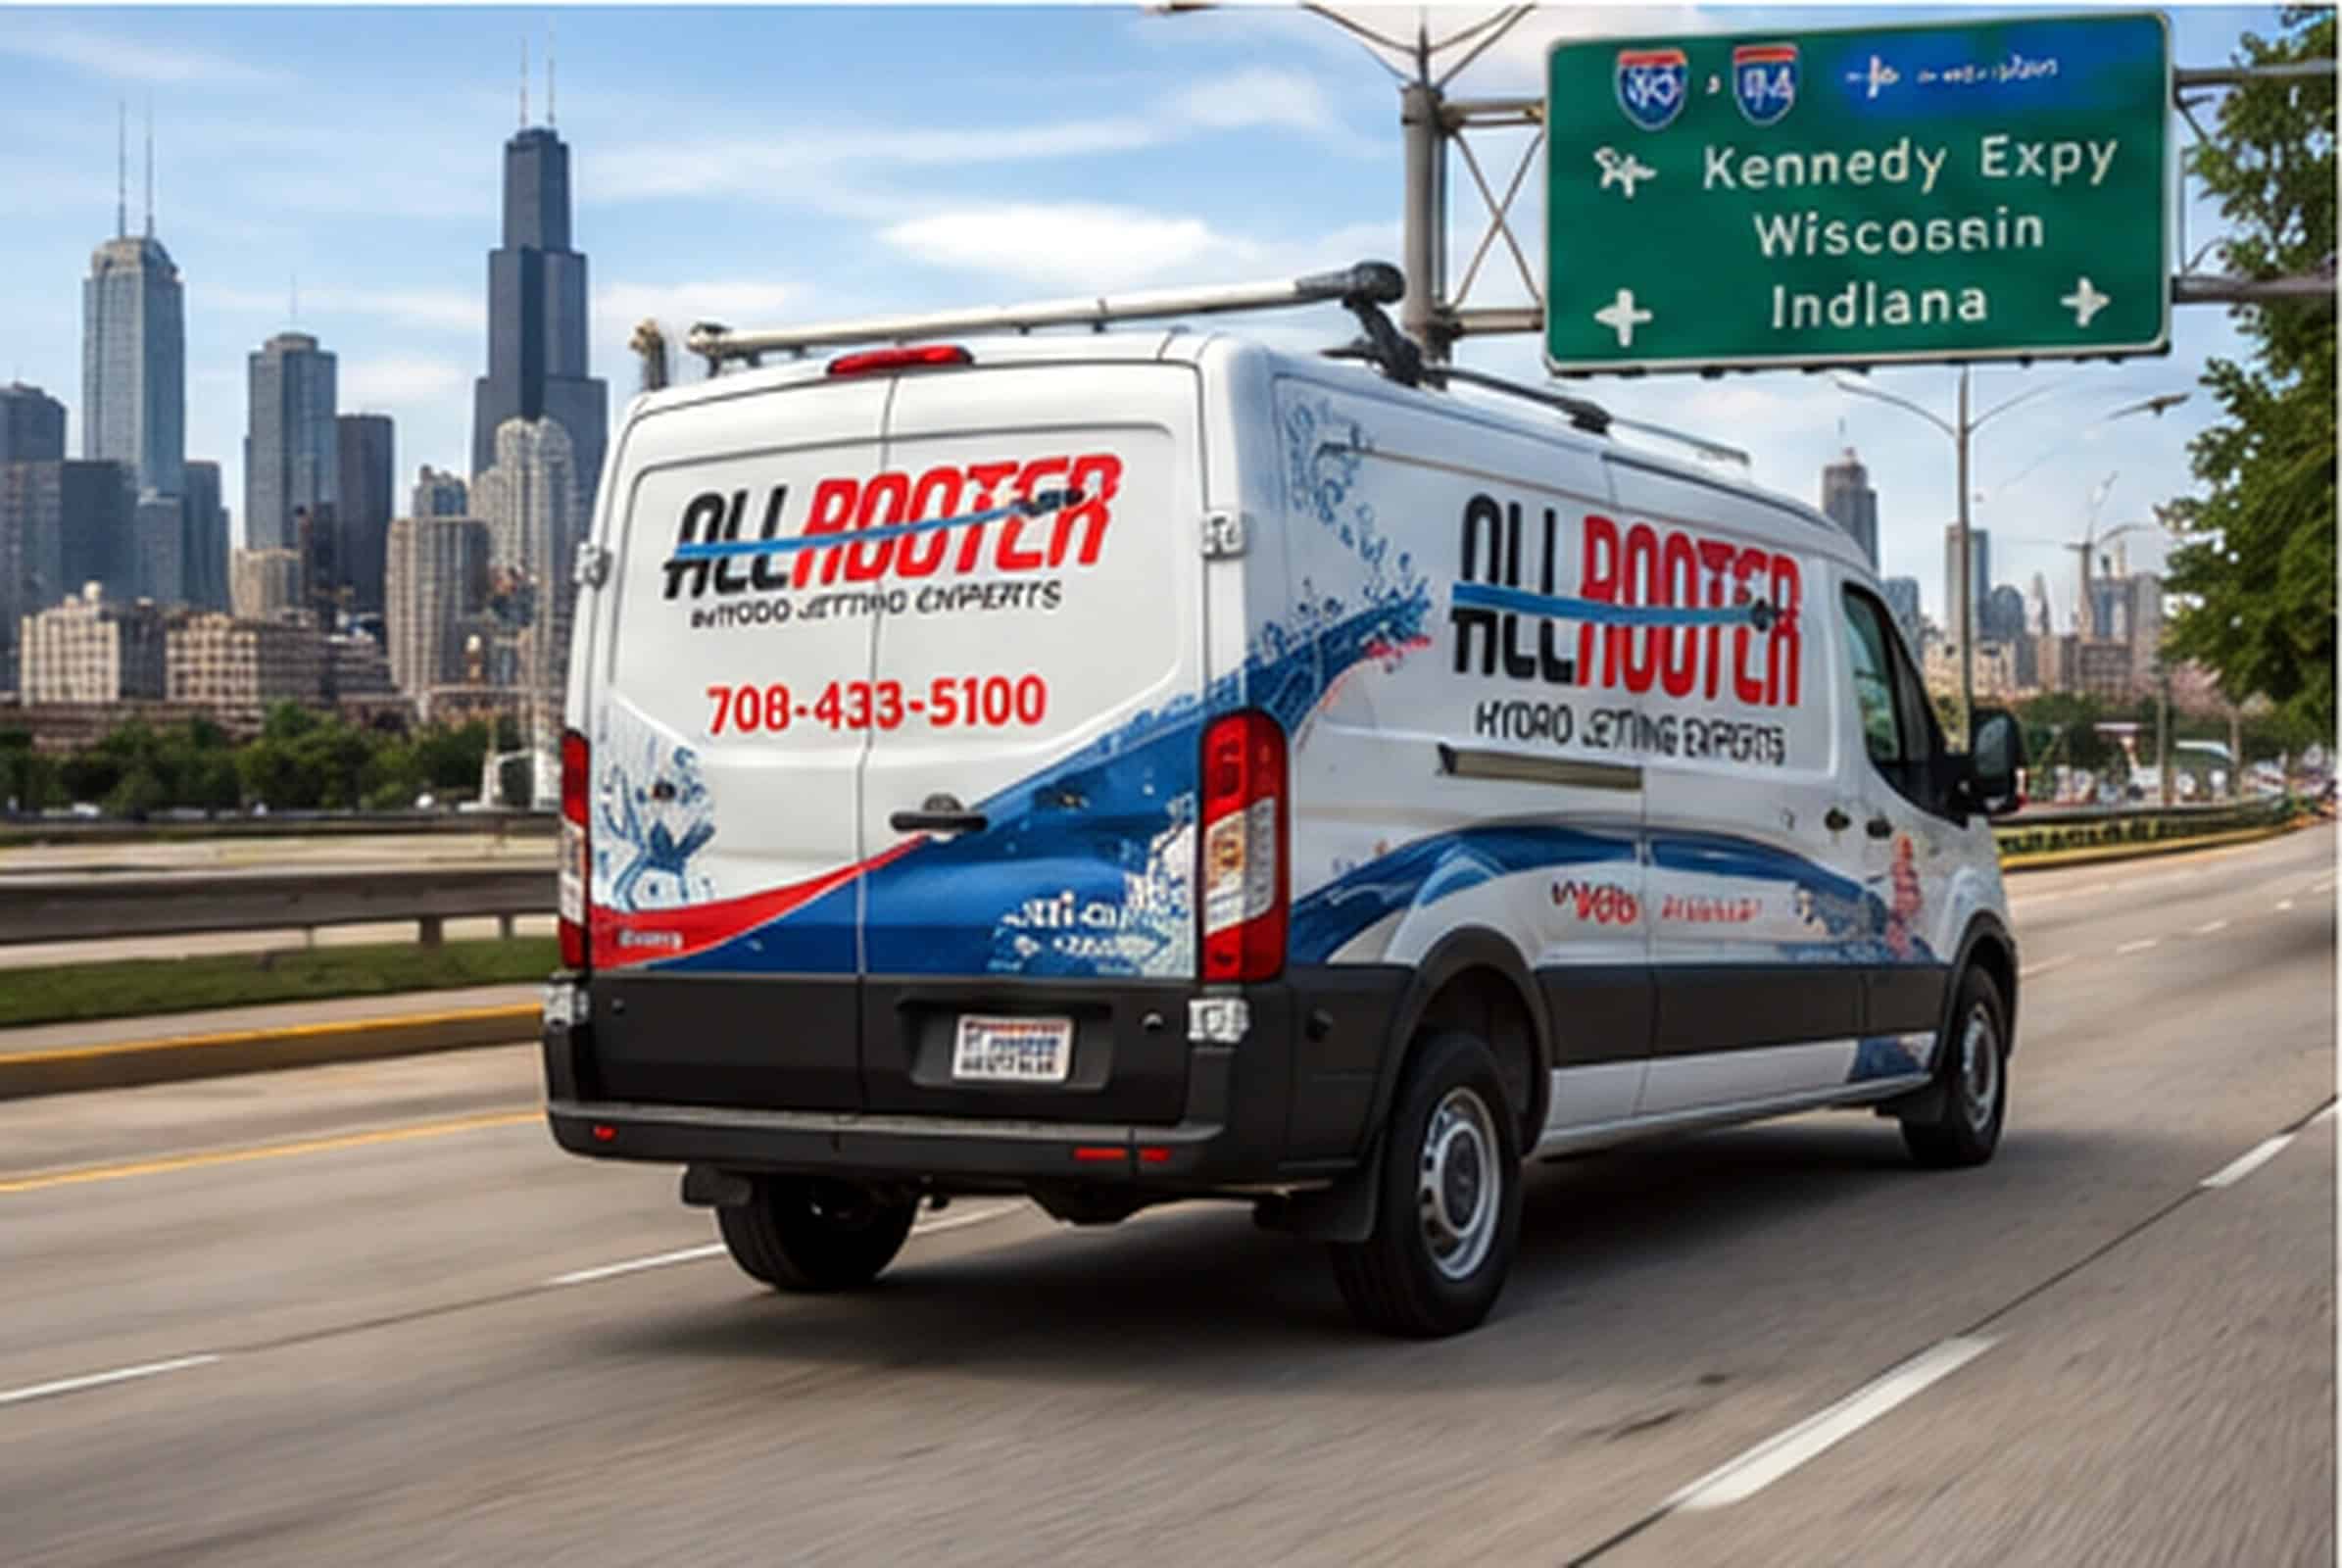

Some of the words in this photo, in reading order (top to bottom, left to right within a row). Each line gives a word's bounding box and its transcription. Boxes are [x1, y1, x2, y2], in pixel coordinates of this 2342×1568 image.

[1702, 135, 1948, 195] Kennedy
[1979, 133, 2119, 186] Expy
[706, 674, 1048, 736] 708-433-5100
